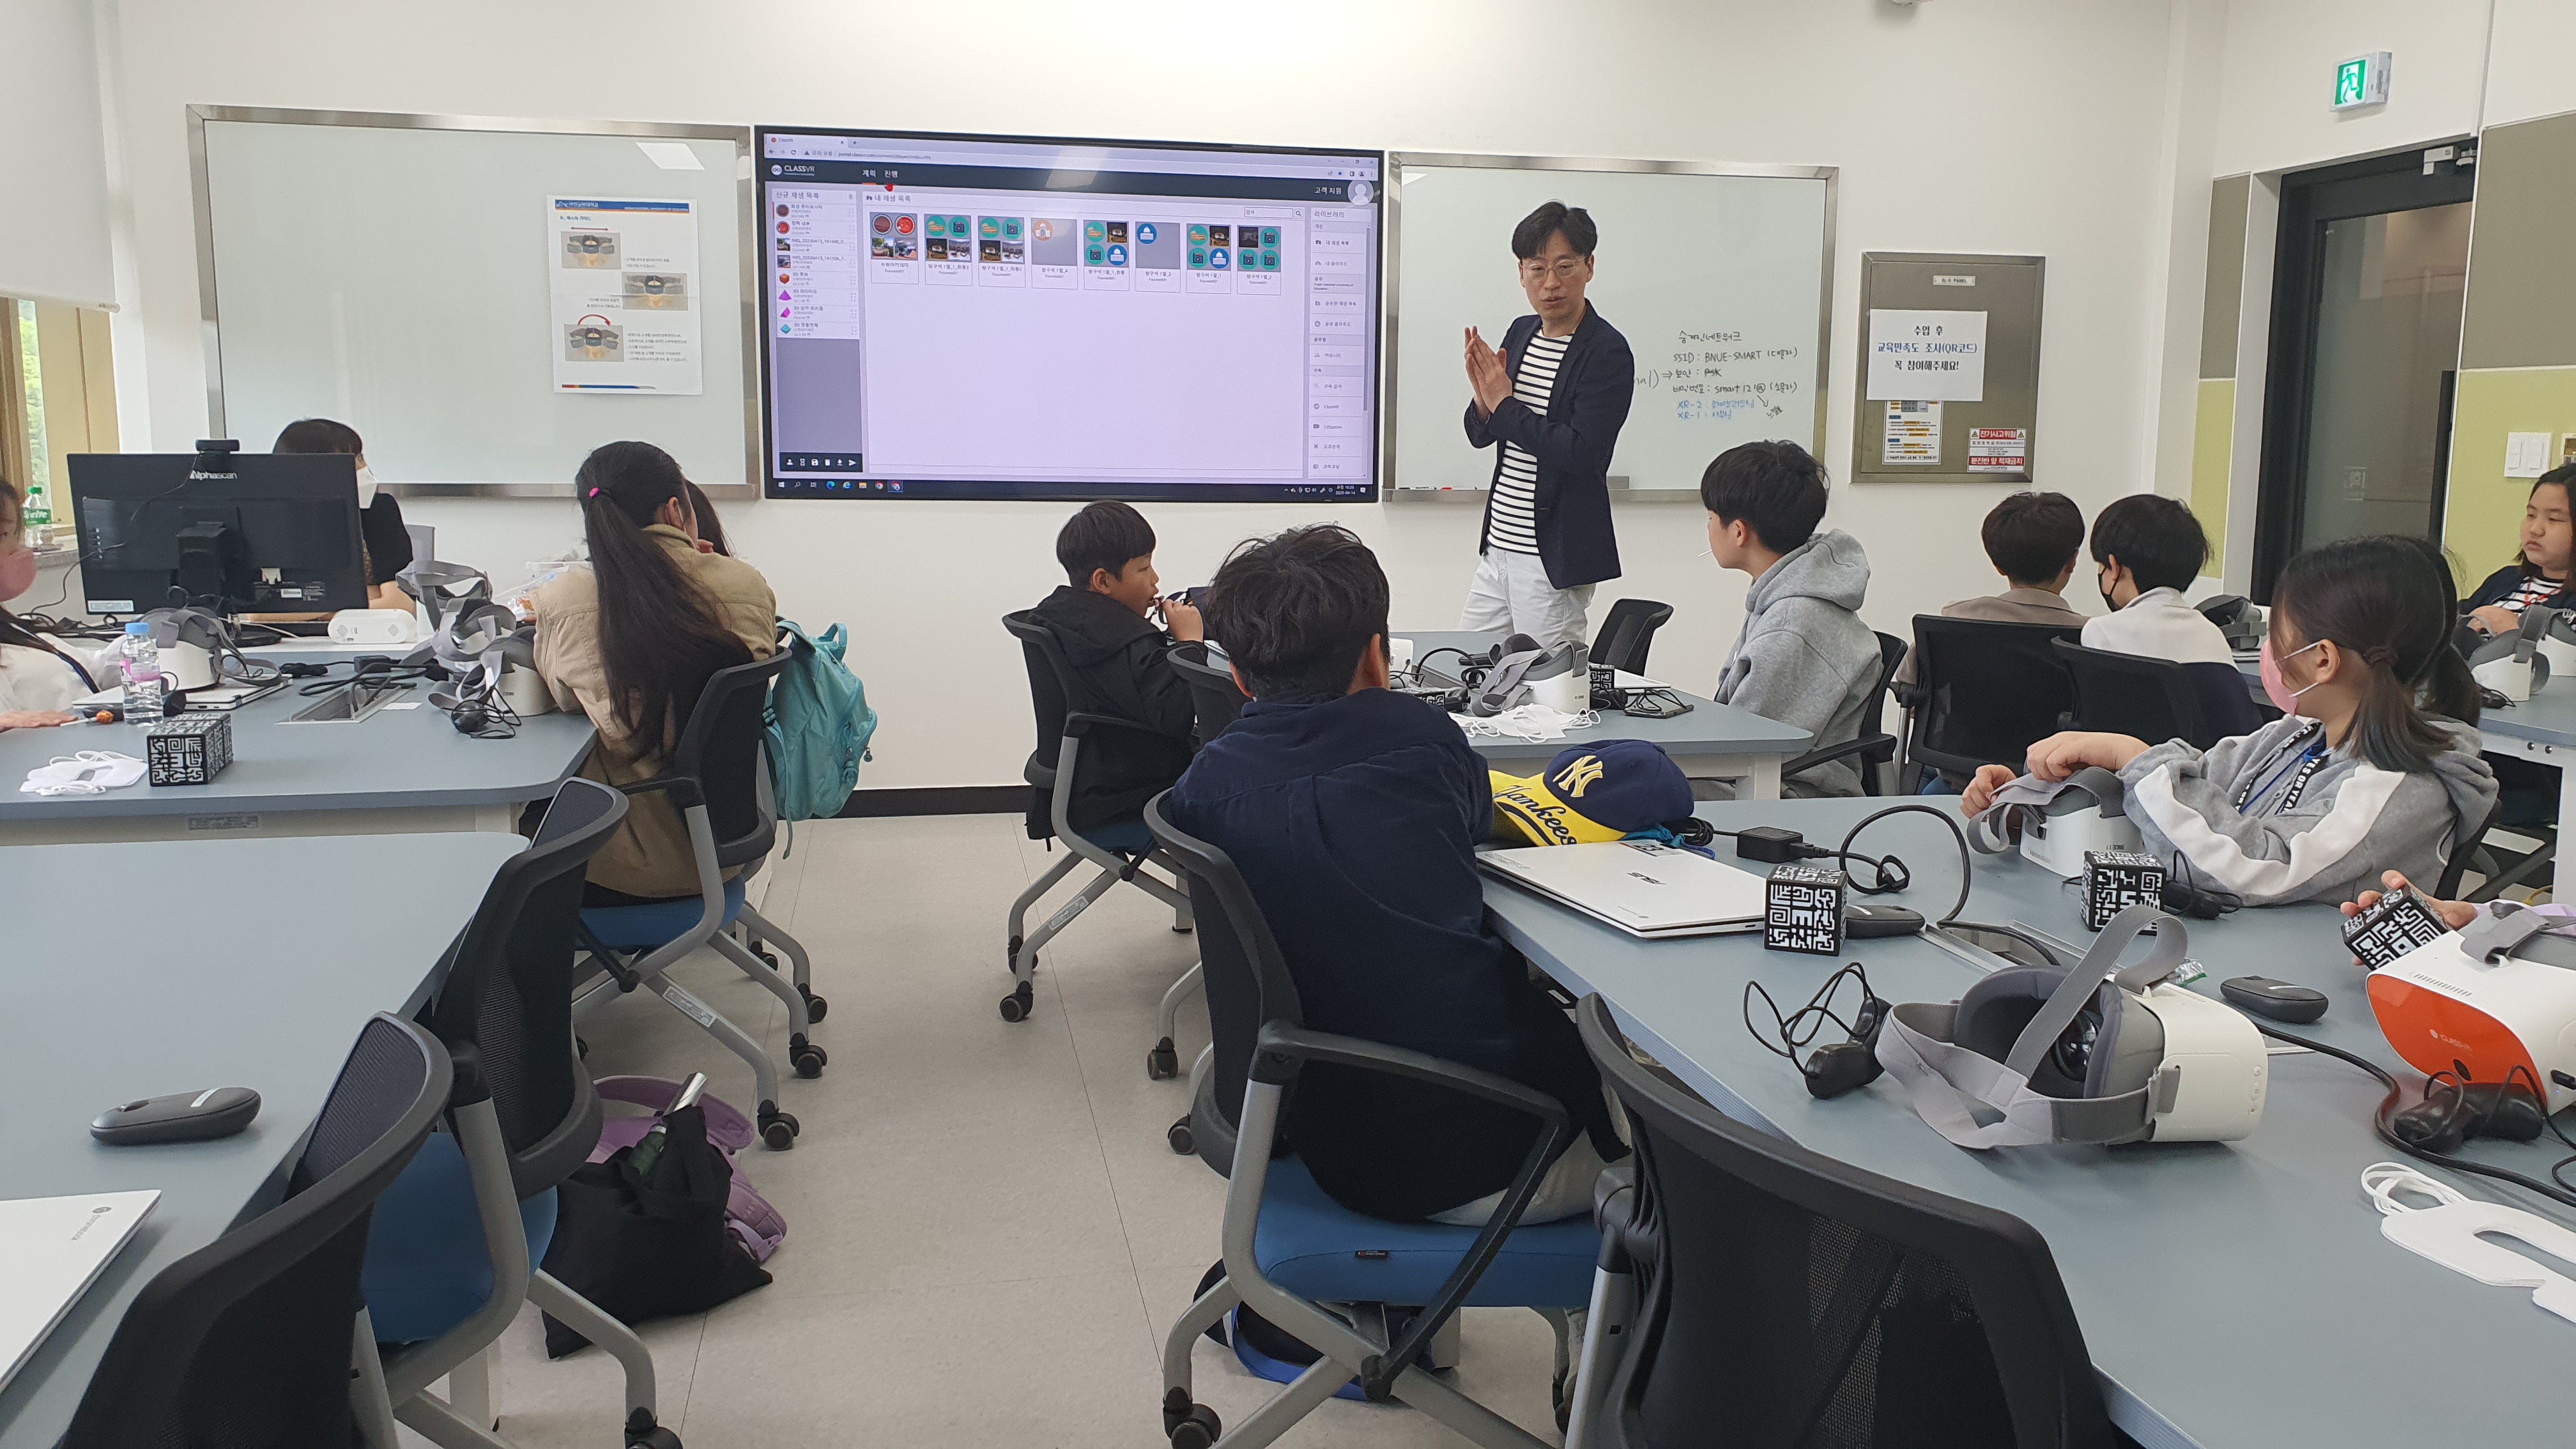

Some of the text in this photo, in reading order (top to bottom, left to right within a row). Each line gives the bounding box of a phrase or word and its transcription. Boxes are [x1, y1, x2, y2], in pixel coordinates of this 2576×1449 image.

[862, 169, 877, 178] 계획
[884, 170, 898, 178] 진행
[1314, 187, 1342, 195] 고객 지원
[1914, 325, 1943, 336] 수업 후
[1877, 342, 1977, 354] 교육만족도 조사(QR코드)
[1705, 351, 1762, 363] BNUE-SMART
[1894, 360, 1959, 371] 꼭 참여해주세요!
[2284, 758, 2320, 812] YES OR YEA
